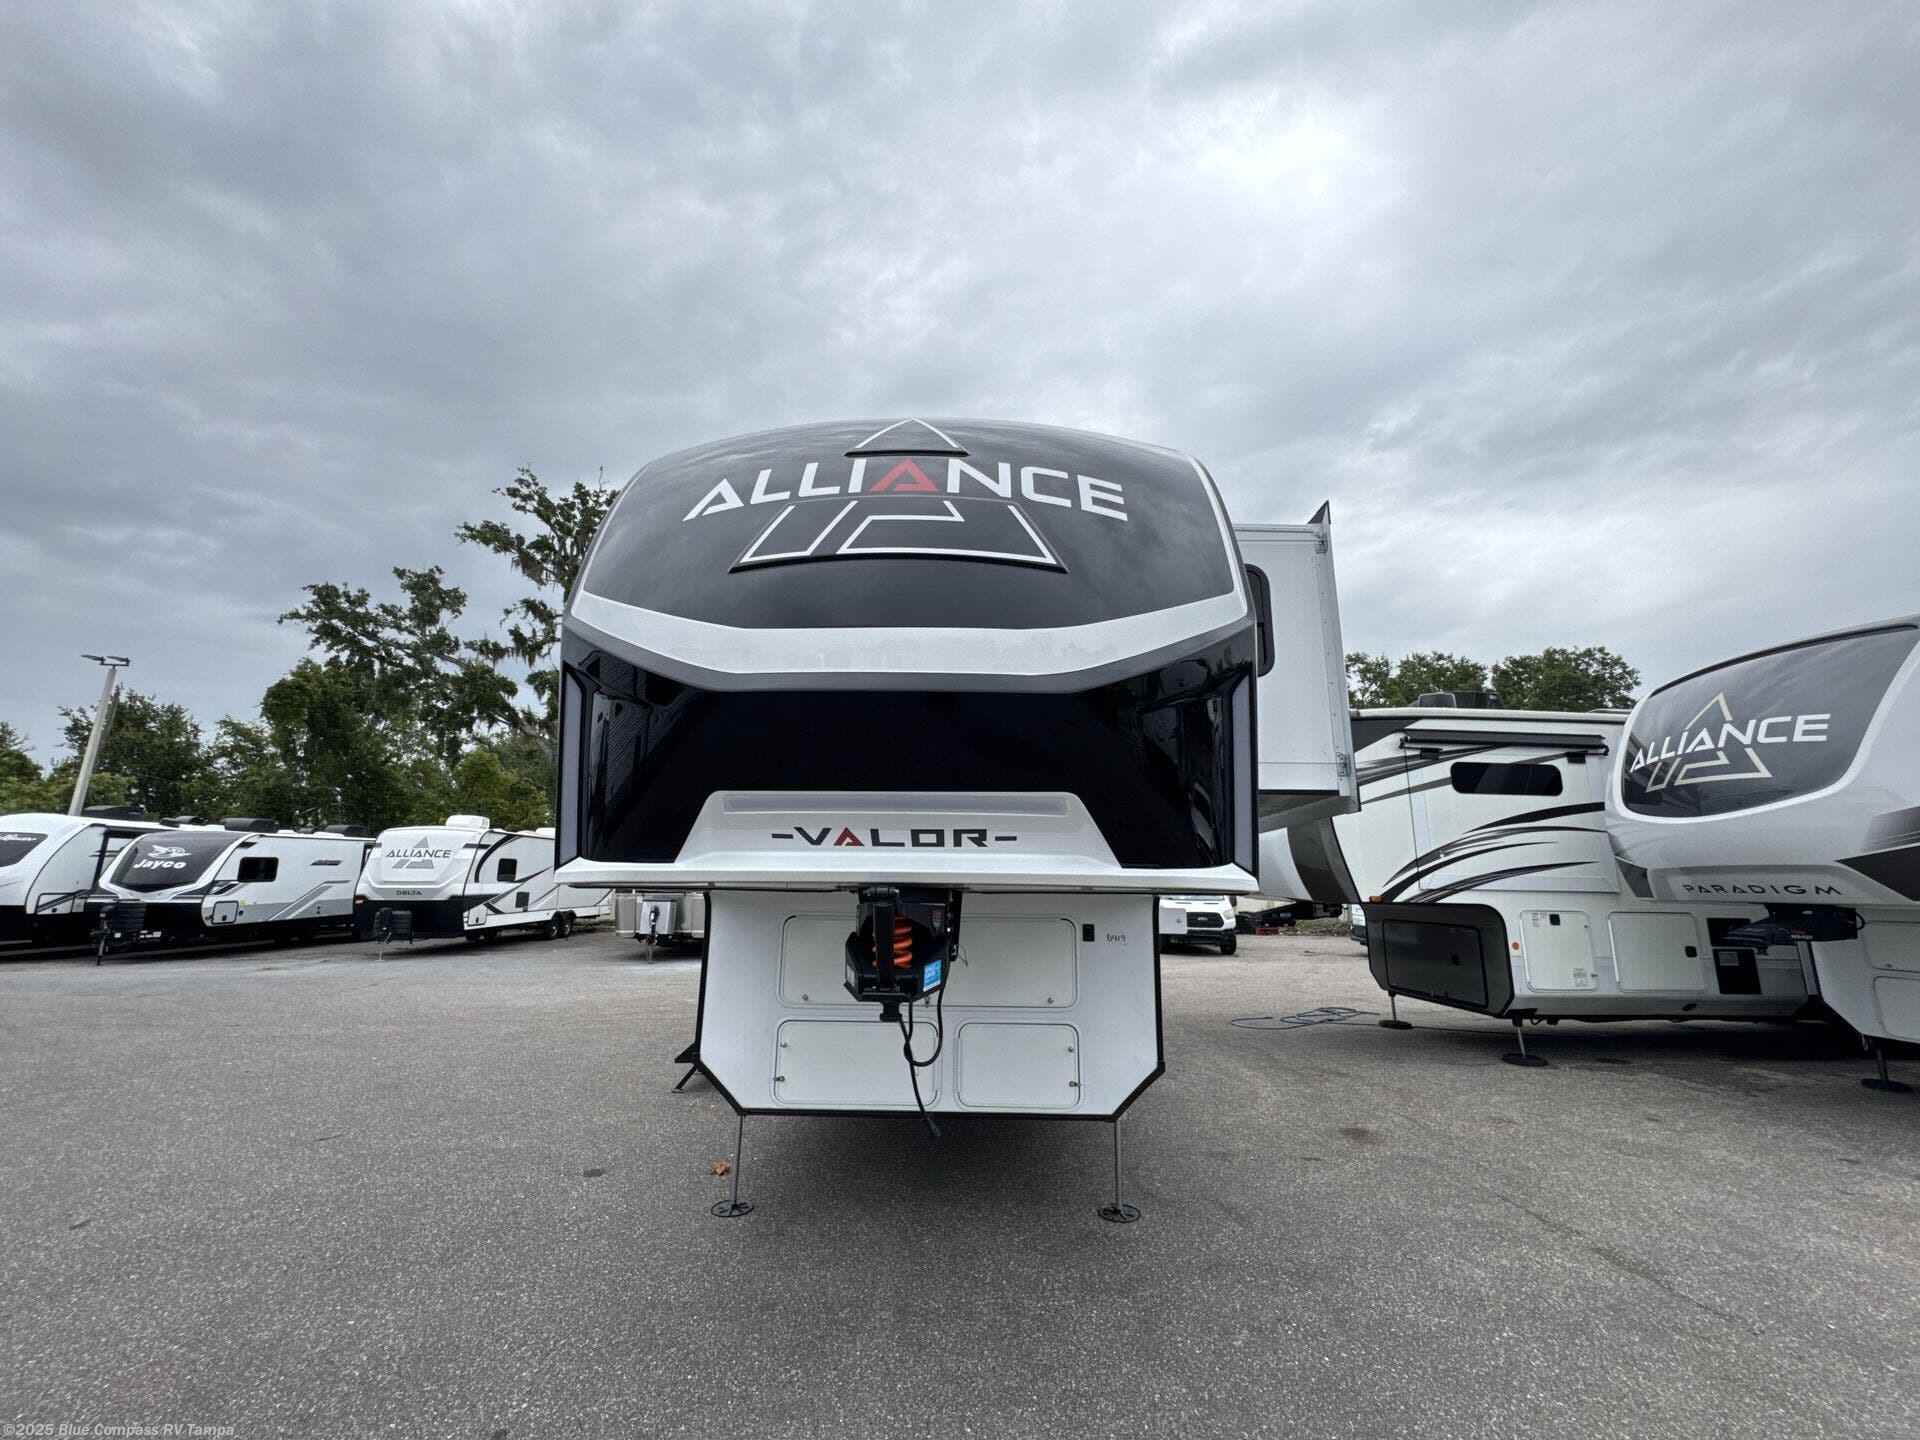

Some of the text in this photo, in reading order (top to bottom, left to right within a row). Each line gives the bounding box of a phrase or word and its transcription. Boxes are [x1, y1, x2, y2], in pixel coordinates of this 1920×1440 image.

[682, 457, 1128, 522] ALLIANCE
[1630, 713, 1832, 773] ALLIANCE
[385, 849, 452, 859] ALLIANCE
[133, 859, 187, 870] Jayco
[1682, 884, 1843, 896] PARADIGM
